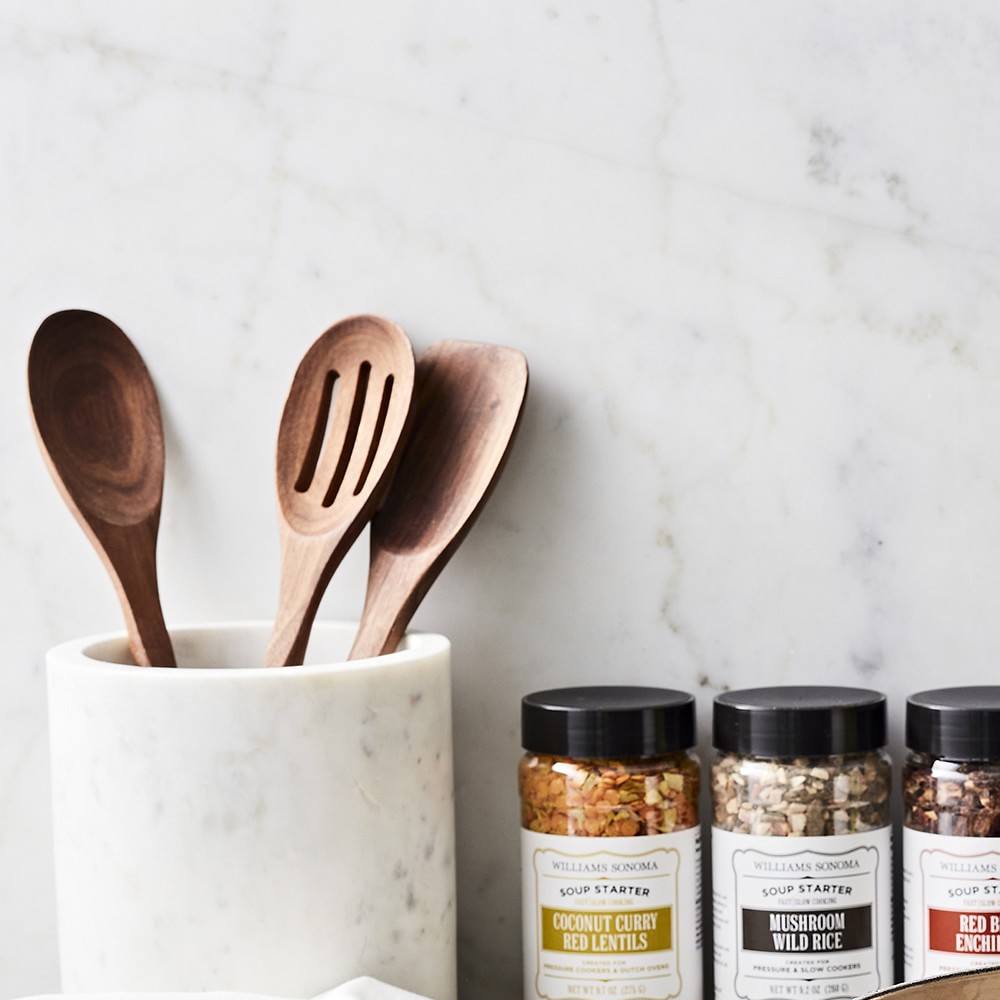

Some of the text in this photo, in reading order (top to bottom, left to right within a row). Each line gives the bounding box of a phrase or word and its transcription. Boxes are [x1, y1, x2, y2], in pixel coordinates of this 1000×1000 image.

[552, 860, 659, 873] WILLIAMS SONOMA
[754, 859, 860, 873] WILLIAMS SONOMA
[940, 861, 998, 873] WILLIAMS
[560, 885, 651, 898] SOUP STARTER
[762, 884, 853, 897] SOUP STARTER
[948, 886, 979, 898] SOUP
[553, 912, 658, 932] COCONUT CURRY
[769, 912, 845, 932] MUSHROOM
[960, 914, 987, 933] RED
[563, 932, 648, 952] RED LENTILS
[773, 932, 843, 951] WILD RICE
[753, 965, 790, 973] PRESSURE
[826, 962, 861, 972] COOKERS
